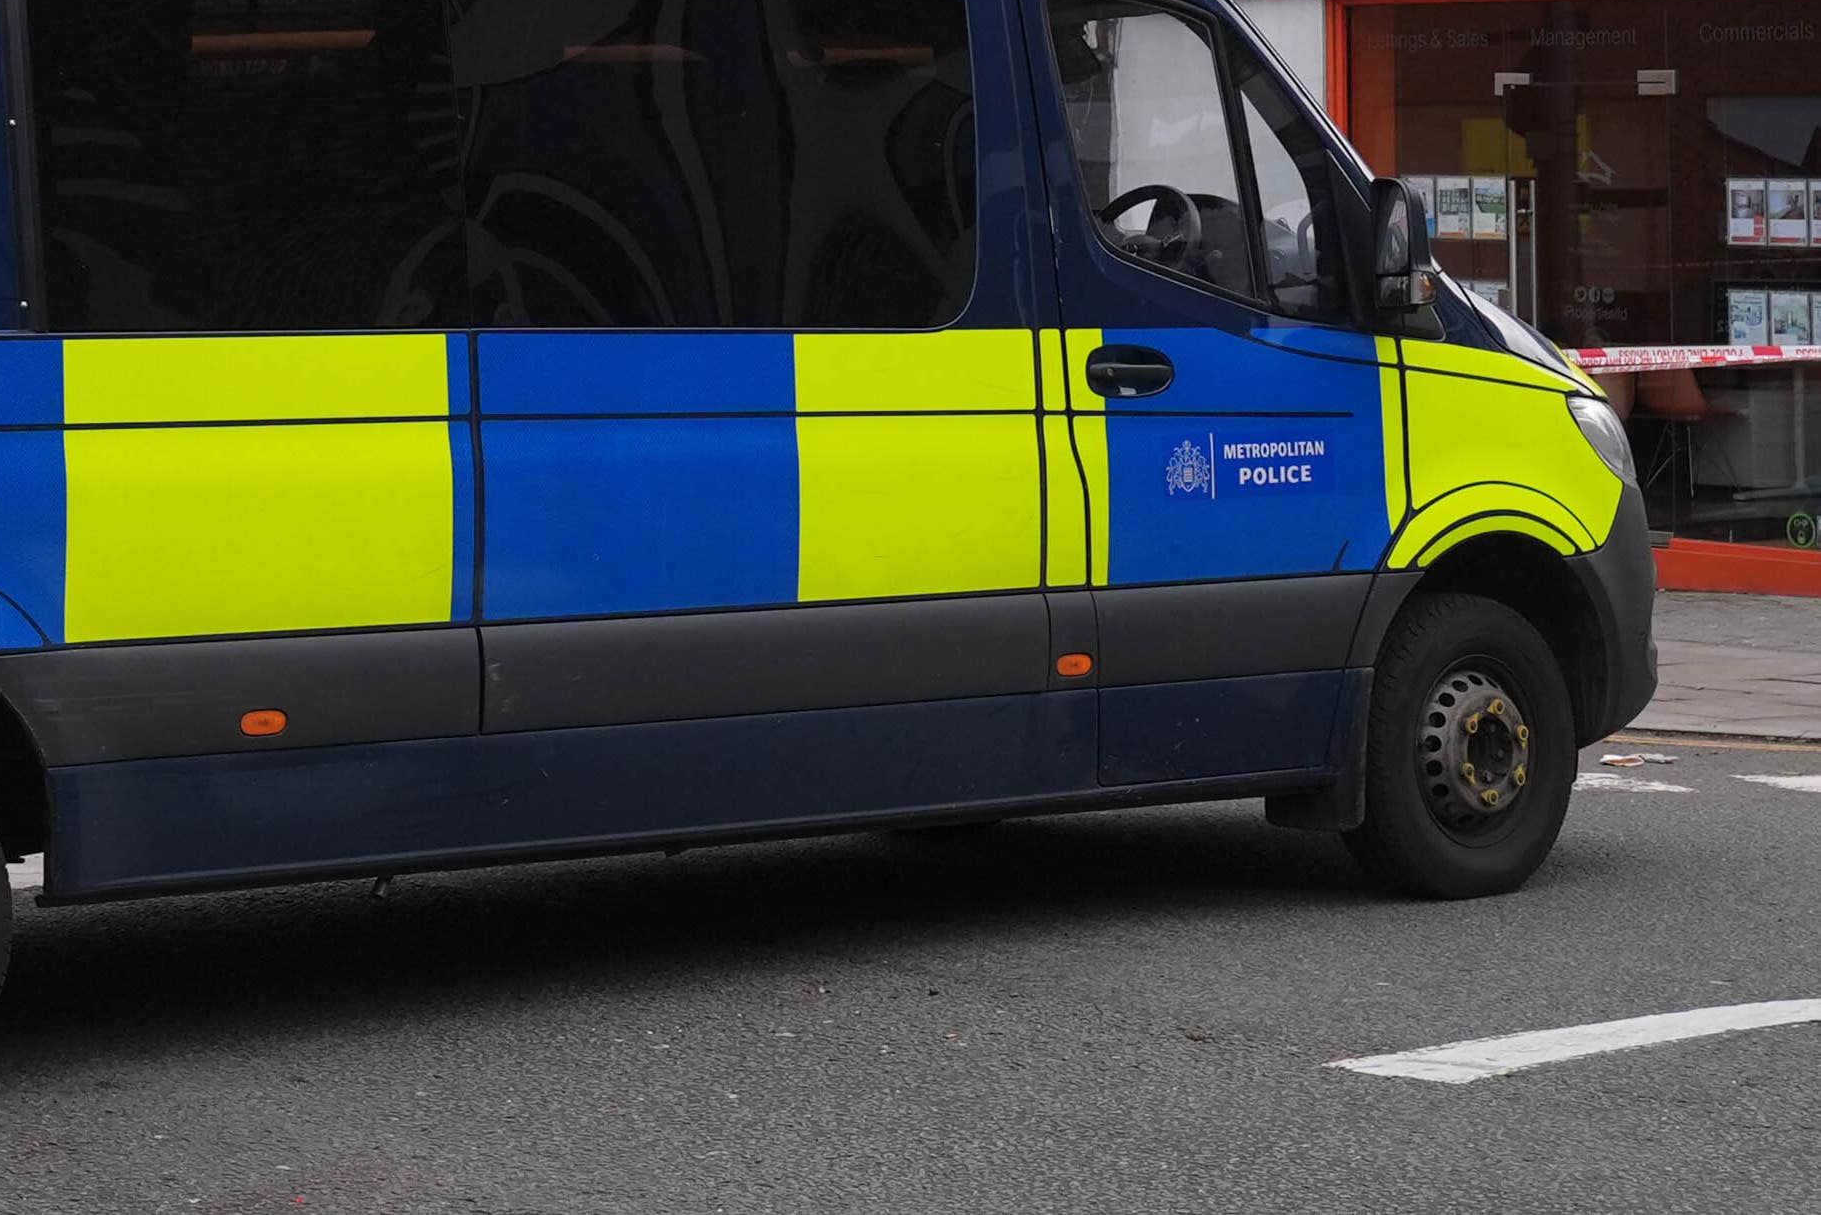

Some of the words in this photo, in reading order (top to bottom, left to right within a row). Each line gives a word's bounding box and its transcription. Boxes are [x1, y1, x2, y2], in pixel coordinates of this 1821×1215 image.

[1447, 29, 1488, 47] Sales
[1530, 26, 1637, 50] Management
[1698, 22, 1814, 43] Commercials
[1223, 440, 1325, 459] METROPOLITAN
[1238, 465, 1312, 485] POLICE
